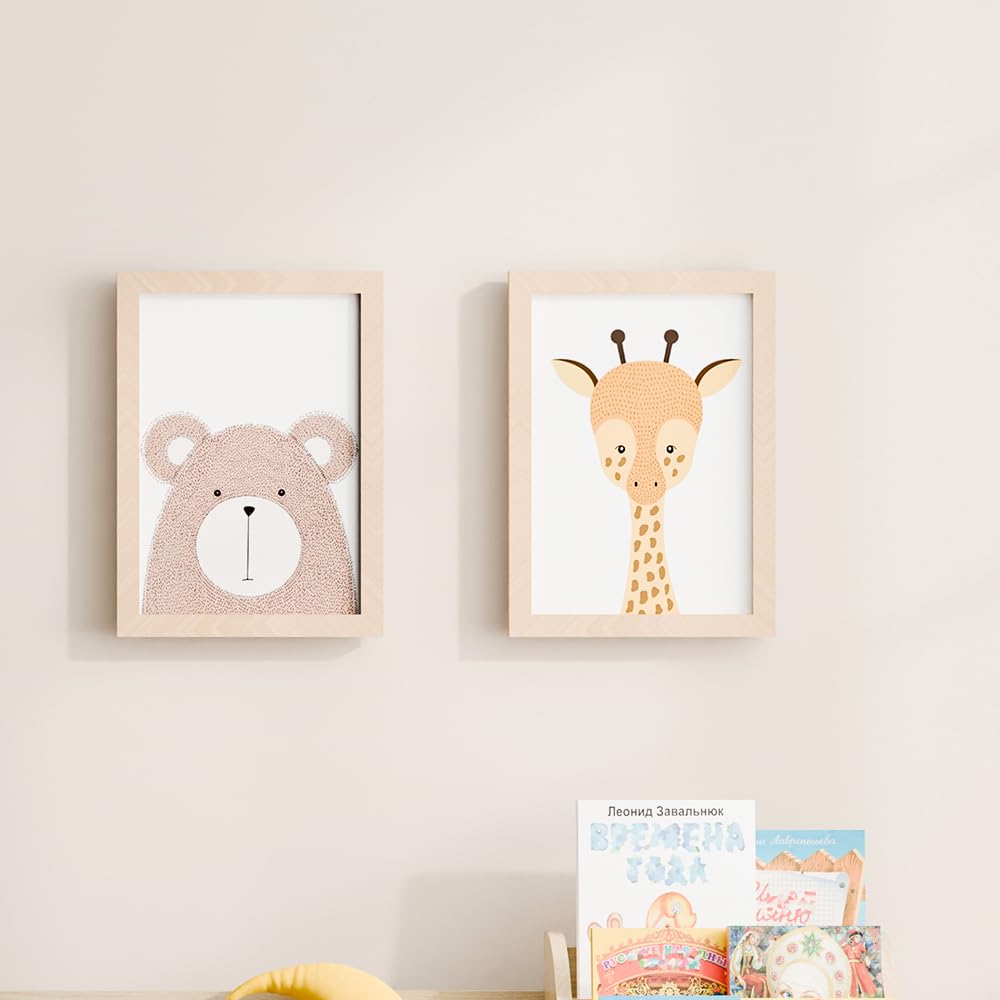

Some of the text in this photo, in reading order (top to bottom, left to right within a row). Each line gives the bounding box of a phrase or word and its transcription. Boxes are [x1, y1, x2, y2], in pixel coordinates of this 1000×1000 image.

[608, 805, 724, 818] Леонид Завальнюк
[590, 822, 745, 852] ВРЕМЕНА
